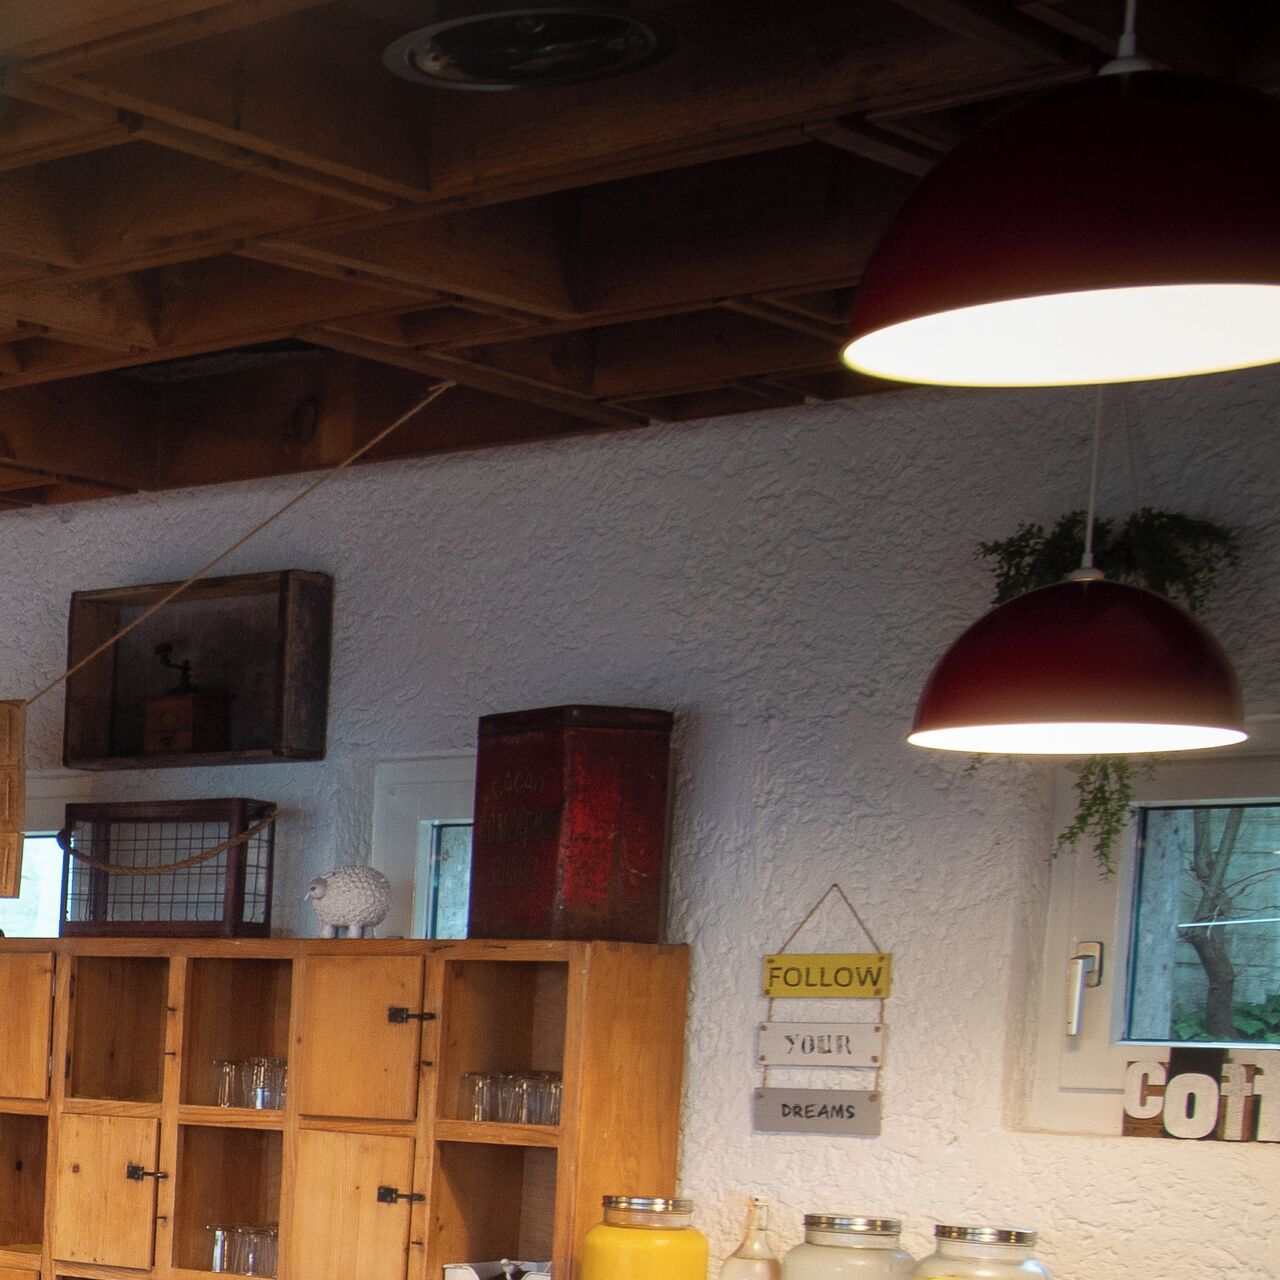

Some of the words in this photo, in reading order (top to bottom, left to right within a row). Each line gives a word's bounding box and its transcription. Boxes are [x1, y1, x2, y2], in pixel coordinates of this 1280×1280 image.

[767, 966, 883, 989] FOLLOW
[783, 1034, 853, 1056] YOUR
[781, 1102, 856, 1120] DREAMS
